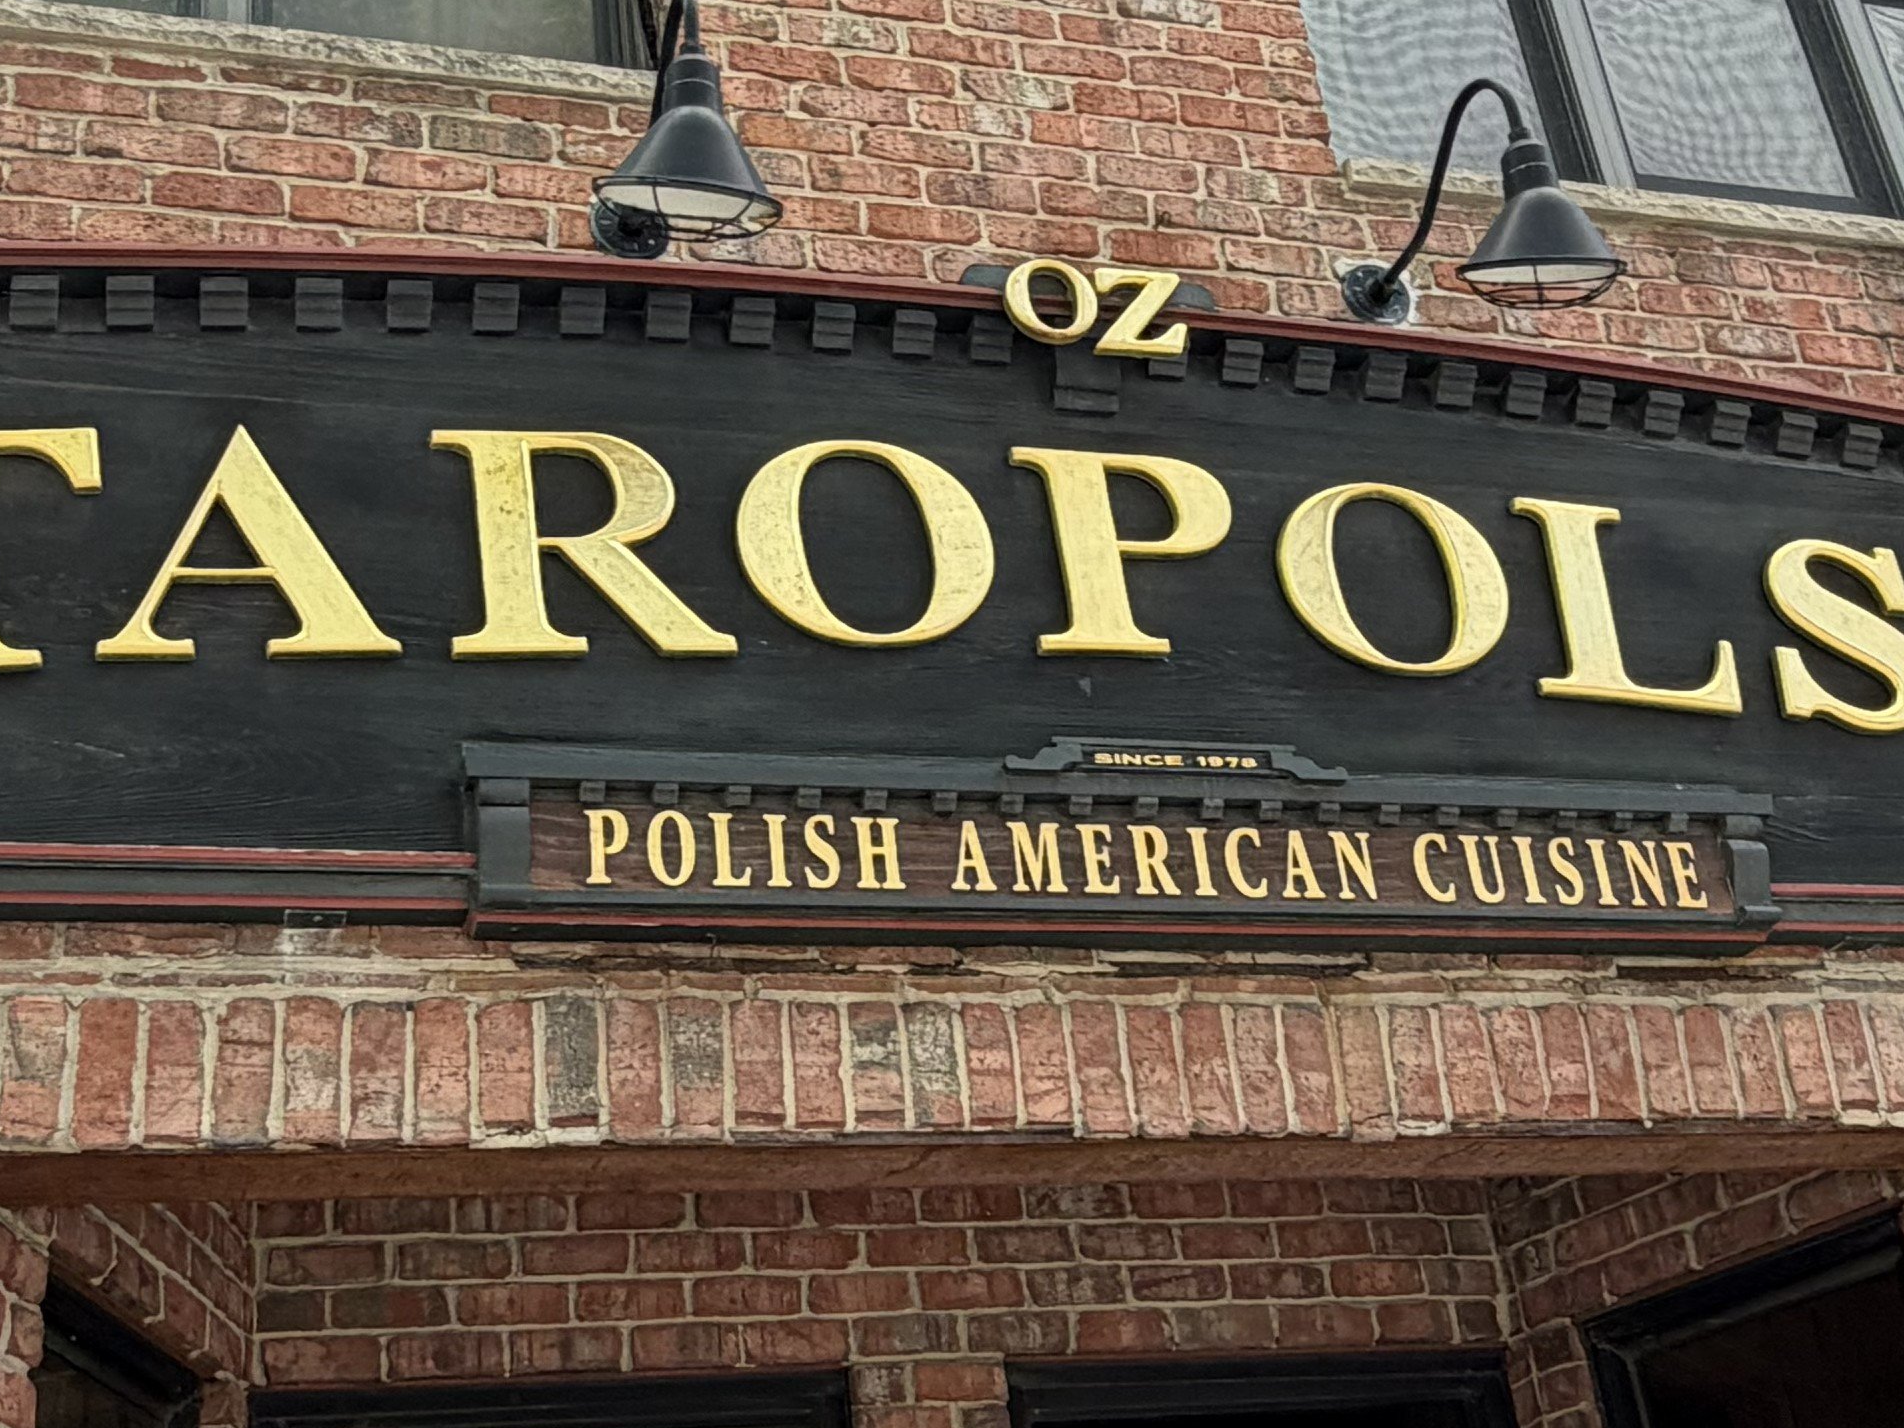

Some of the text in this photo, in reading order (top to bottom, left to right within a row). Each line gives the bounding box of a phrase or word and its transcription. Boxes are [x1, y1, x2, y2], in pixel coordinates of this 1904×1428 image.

[1001, 256, 1189, 358] OZ
[1094, 752, 1184, 767] SINCE
[585, 807, 1710, 910] POLISH AMERICAN CUISINE
